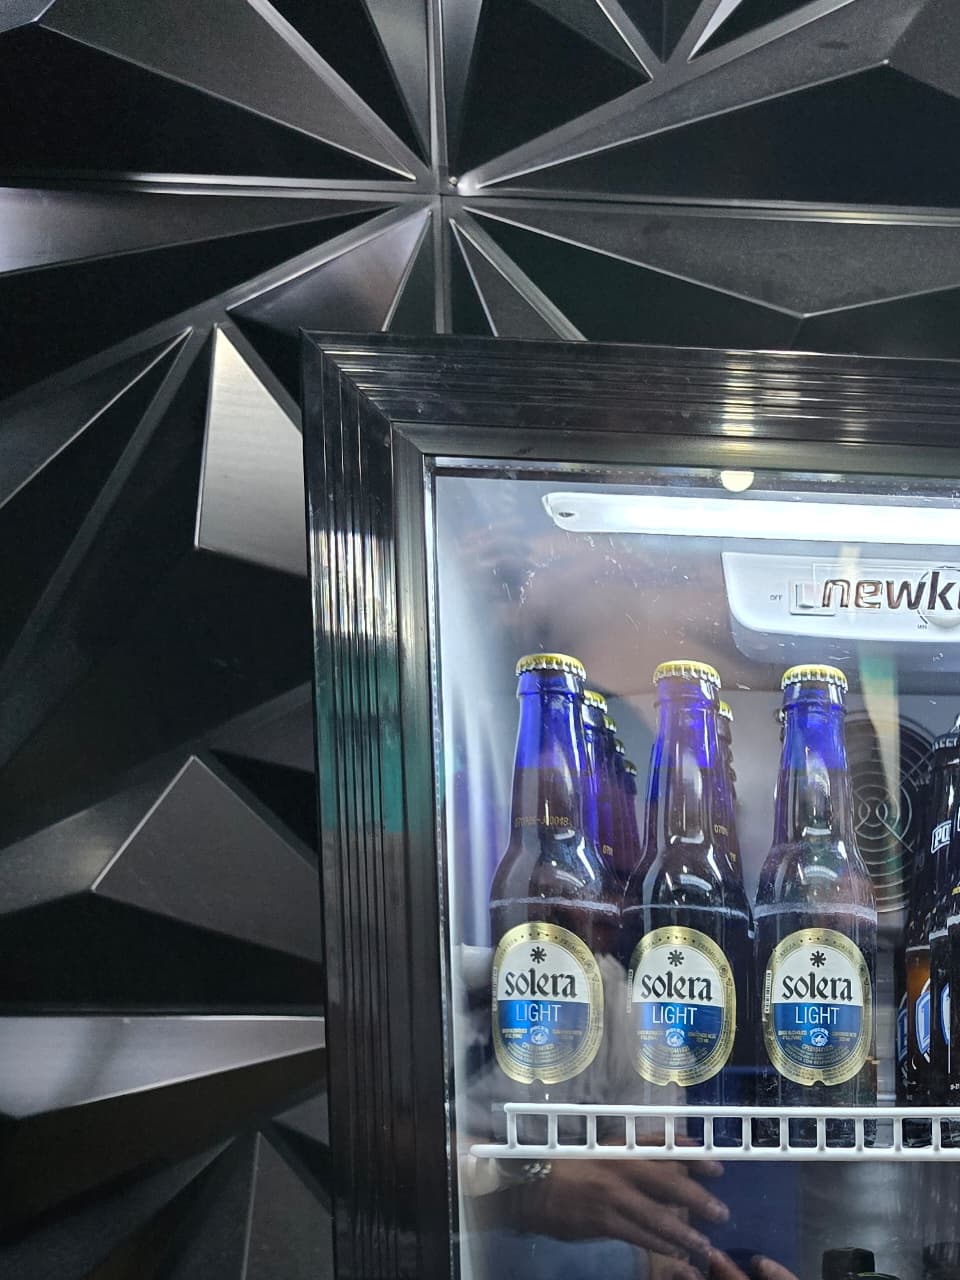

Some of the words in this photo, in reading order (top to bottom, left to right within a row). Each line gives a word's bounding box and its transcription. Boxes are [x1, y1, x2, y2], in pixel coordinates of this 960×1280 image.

[516, 1004, 562, 1022] LIGHT
[652, 1006, 698, 1025] LIGHT
[795, 1006, 840, 1025] LIGHT
